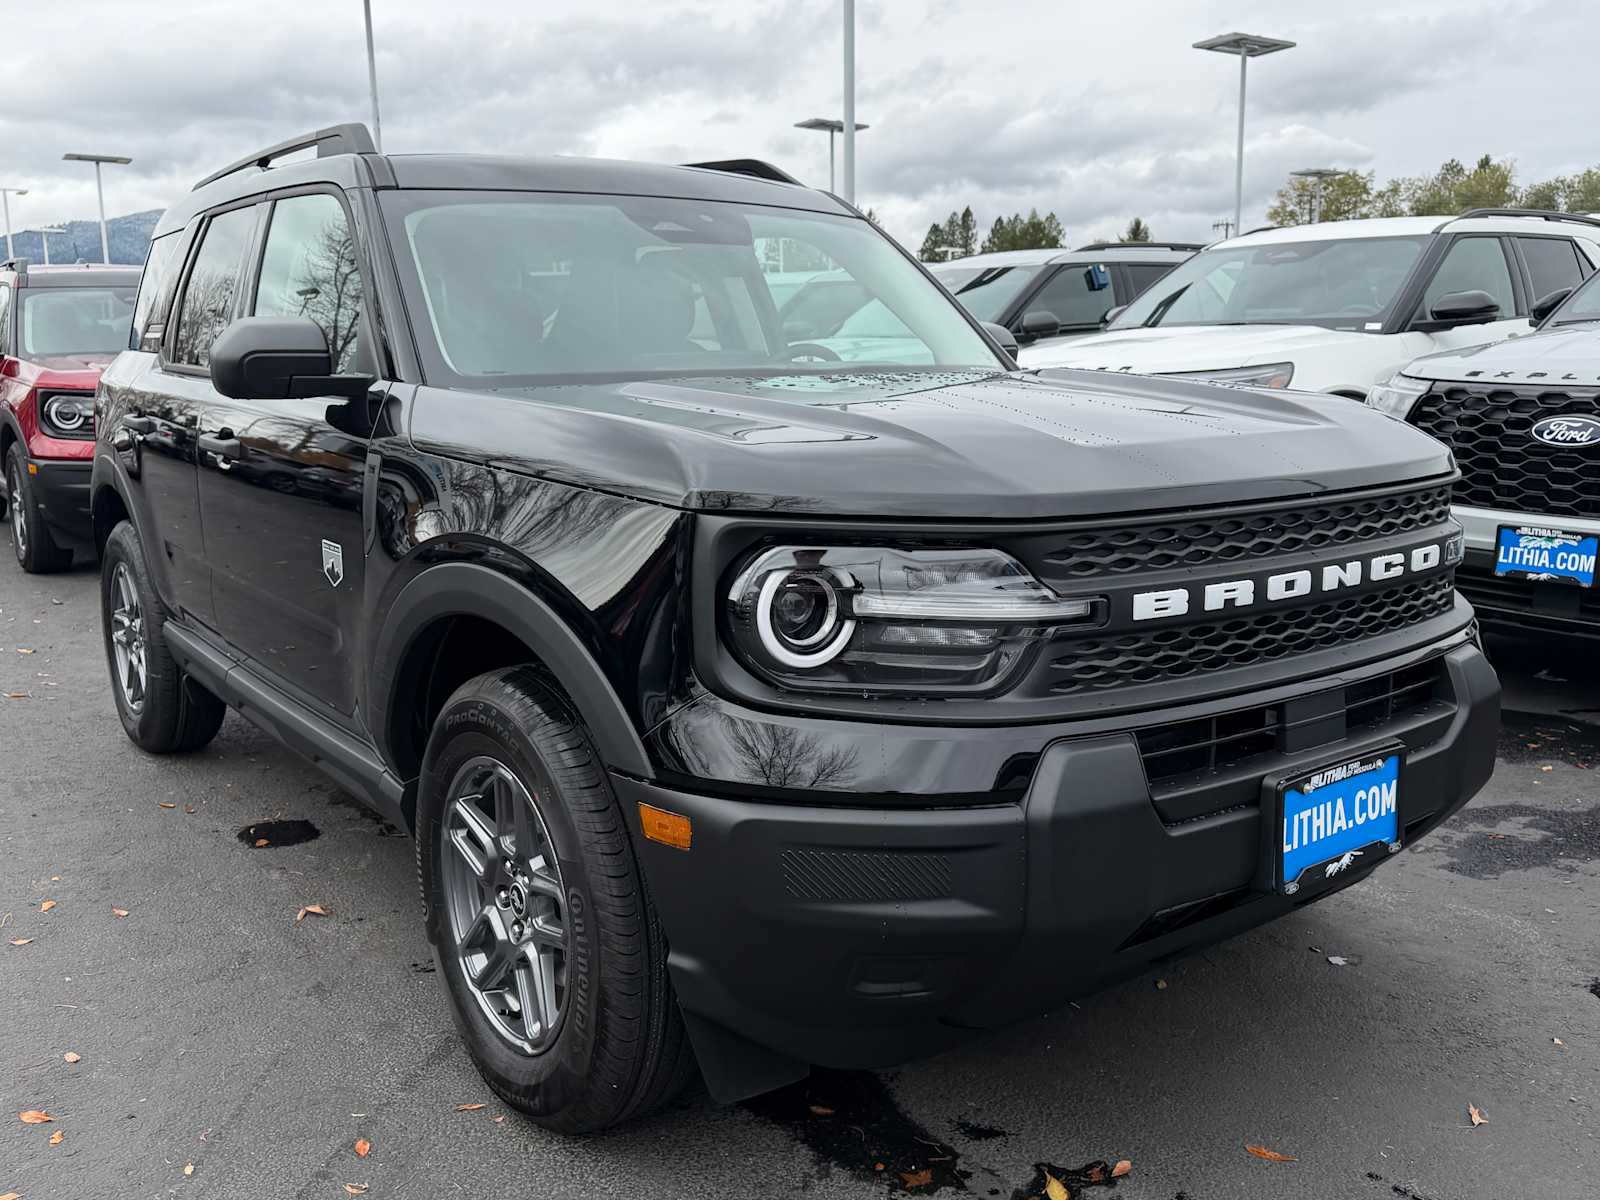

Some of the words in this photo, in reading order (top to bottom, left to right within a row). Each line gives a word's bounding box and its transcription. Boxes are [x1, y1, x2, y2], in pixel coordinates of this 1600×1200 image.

[1465, 371, 1600, 380] EXPL
[1542, 419, 1595, 443] Ford
[1499, 546, 1596, 573] LITHIA.COM
[1132, 544, 1442, 621] BRONCO
[1319, 766, 1347, 787] LITHIA
[1283, 780, 1397, 853] LITHIA.COM
[568, 886, 592, 1040] Continental
